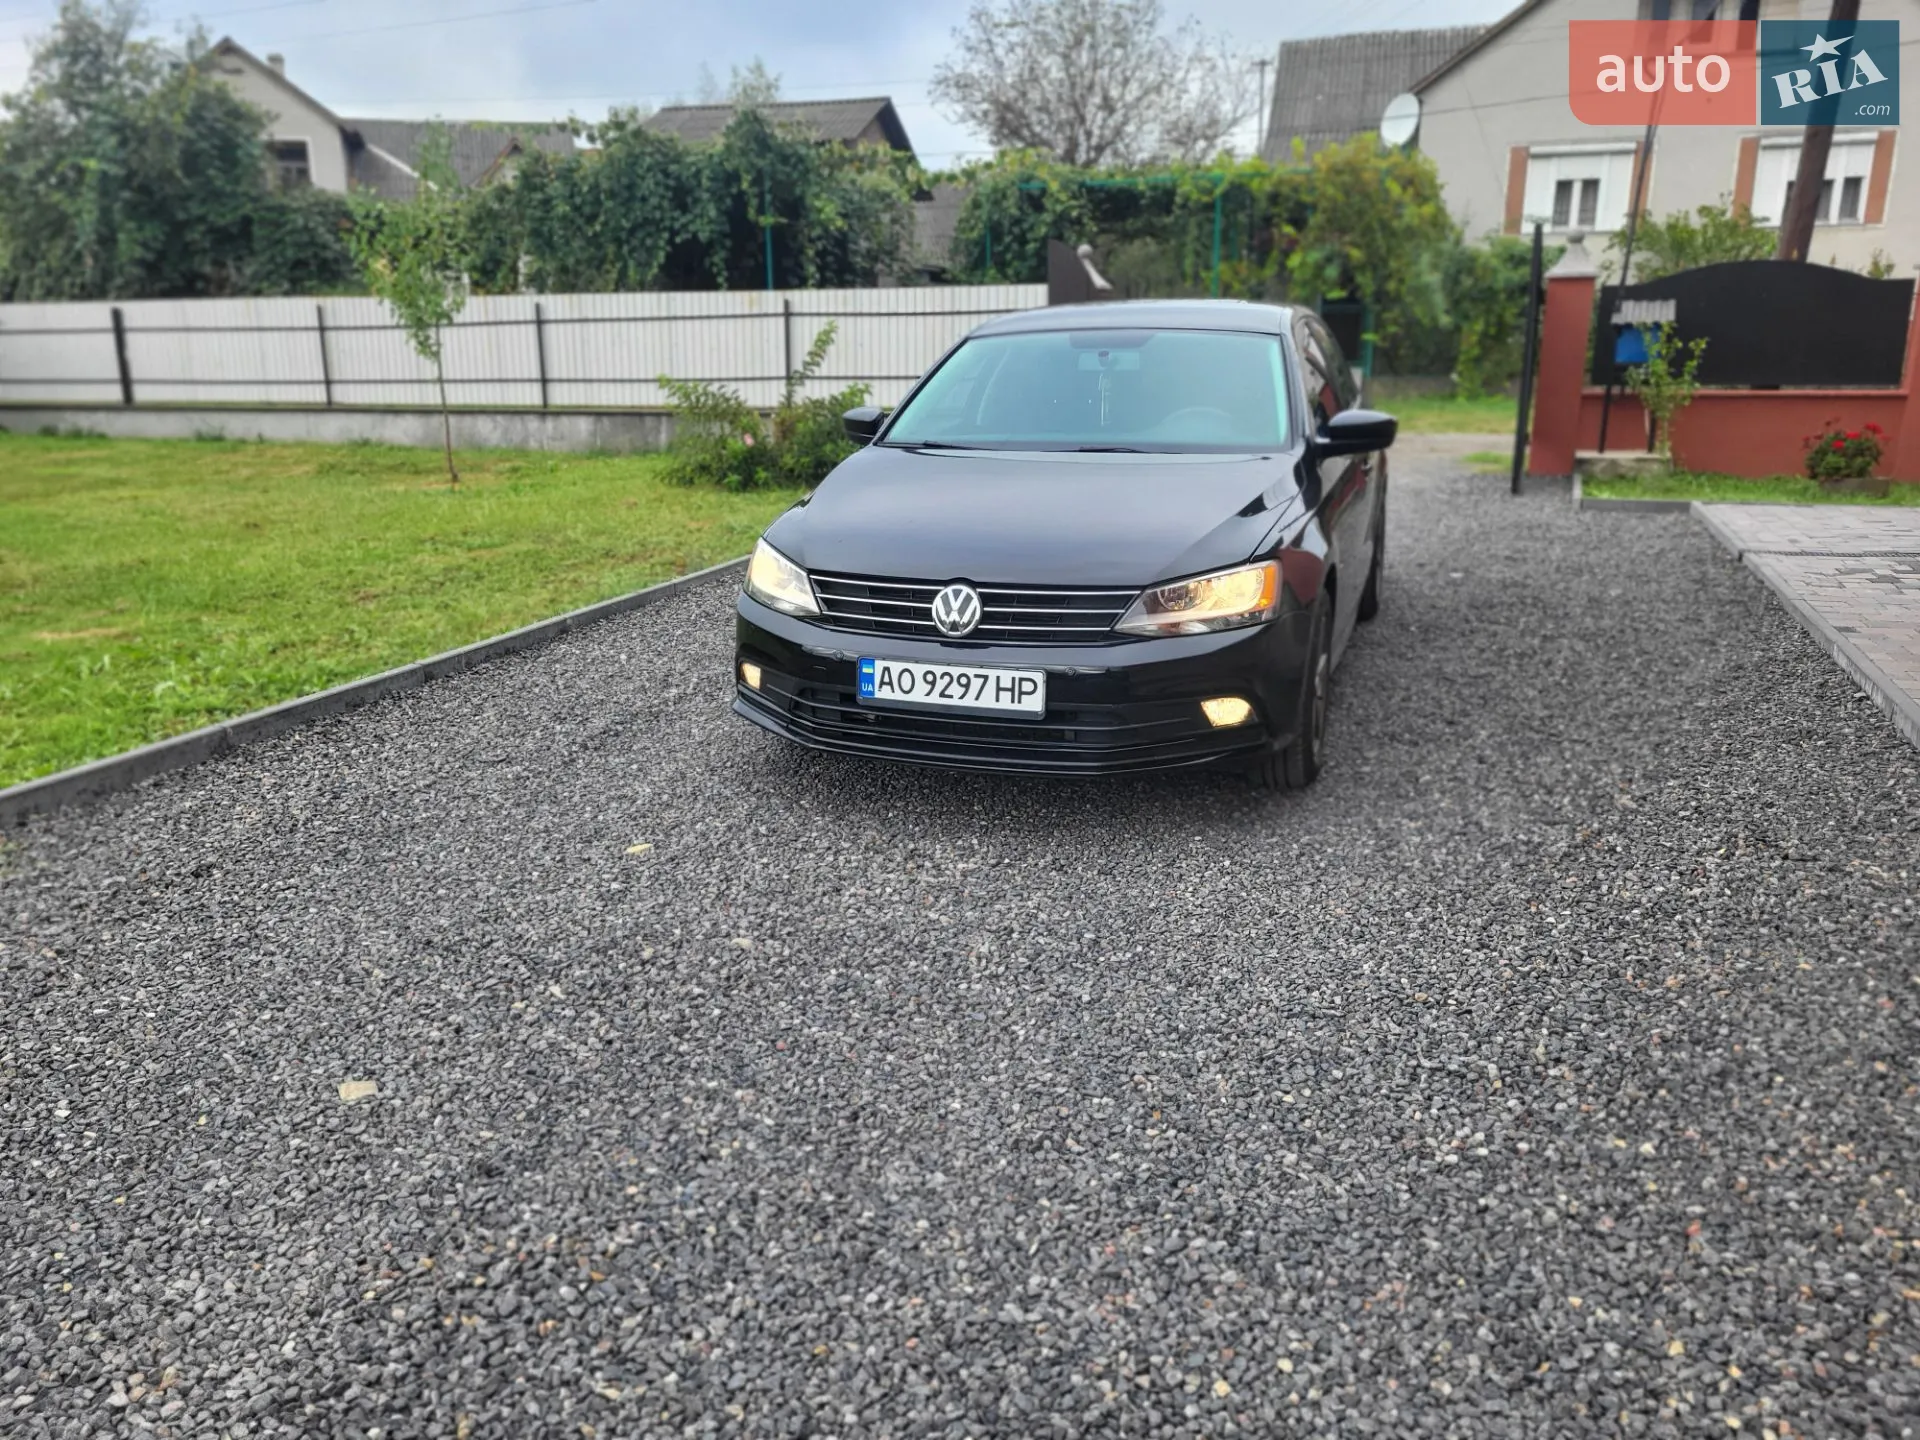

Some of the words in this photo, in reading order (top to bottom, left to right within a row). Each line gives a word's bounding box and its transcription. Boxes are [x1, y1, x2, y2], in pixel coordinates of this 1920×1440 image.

[862, 683, 873, 692] UA
[878, 666, 915, 695] AO
[922, 670, 989, 701] 9297
[995, 675, 1038, 704] HP
